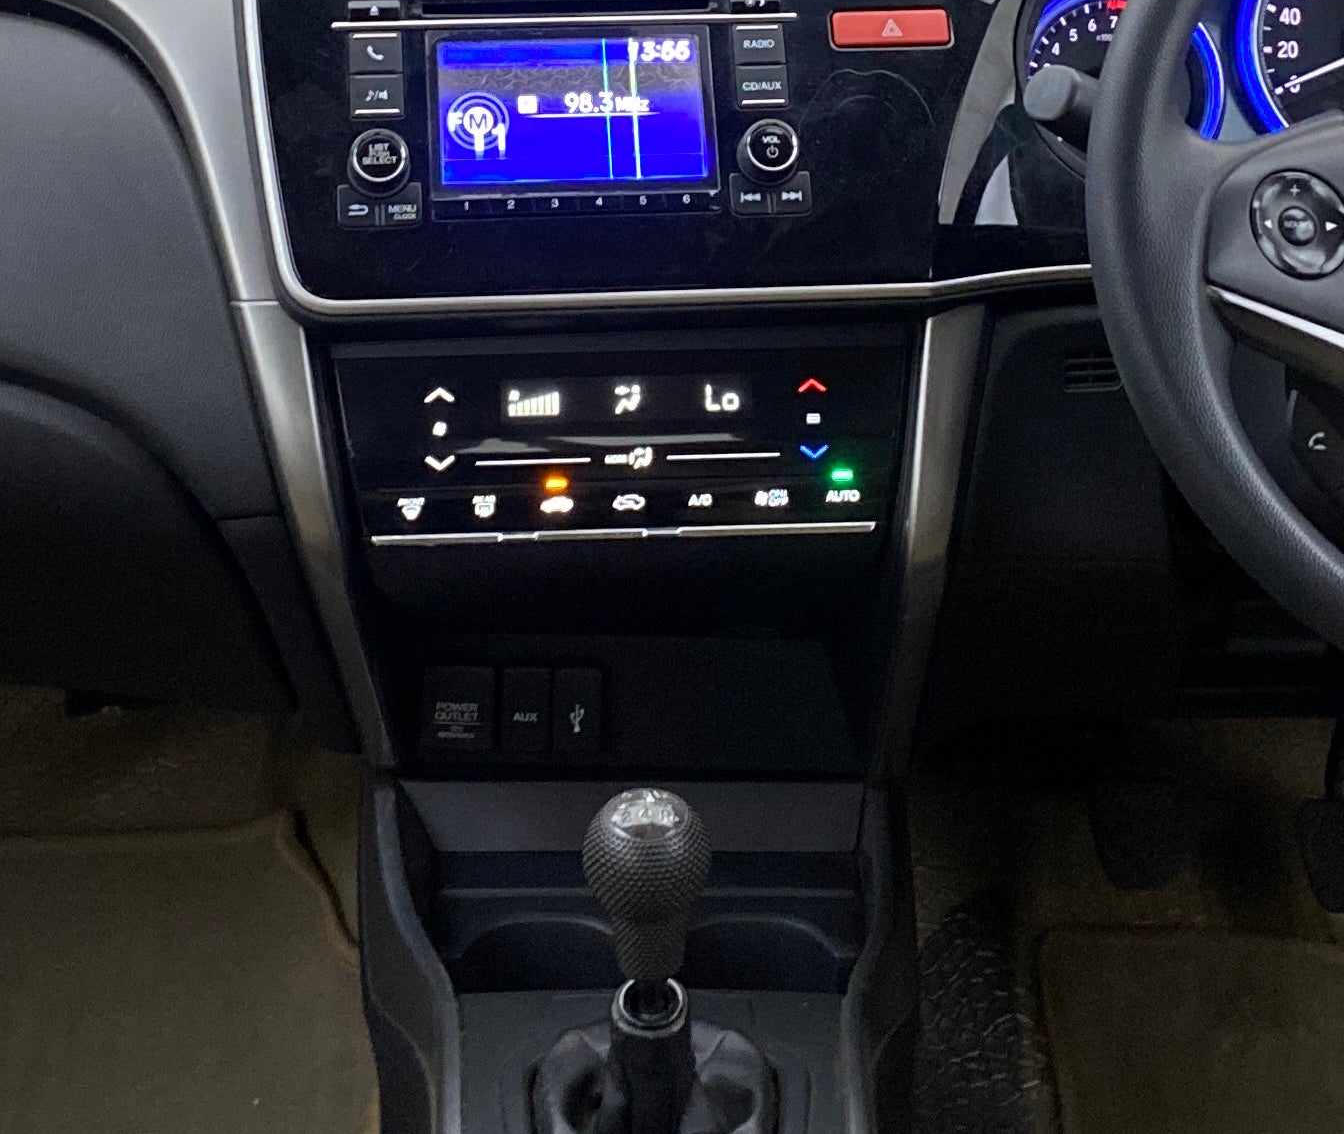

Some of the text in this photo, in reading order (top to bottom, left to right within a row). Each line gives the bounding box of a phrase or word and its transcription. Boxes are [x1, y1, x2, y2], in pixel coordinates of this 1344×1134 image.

[1109, 15, 1118, 29] 7
[1278, 7, 1301, 25] 40
[1088, 18, 1097, 32] 6
[1069, 28, 1078, 42] 5
[743, 39, 775, 49] RADIO
[1051, 42, 1060, 56] 4
[1277, 40, 1299, 59] 20
[742, 81, 782, 91] CD/AUX
[564, 92, 614, 113] 98.3
[762, 135, 781, 144] VOL
[507, 199, 515, 210] 2
[551, 198, 559, 209] 3
[595, 196, 603, 207] 4
[639, 195, 647, 206] 5
[682, 194, 690, 205] 6
[388, 204, 417, 213] MENU
[705, 384, 739, 412] Lo
[688, 493, 712, 507] A/C
[825, 490, 860, 503] AUTO
[513, 712, 538, 722] AUX
